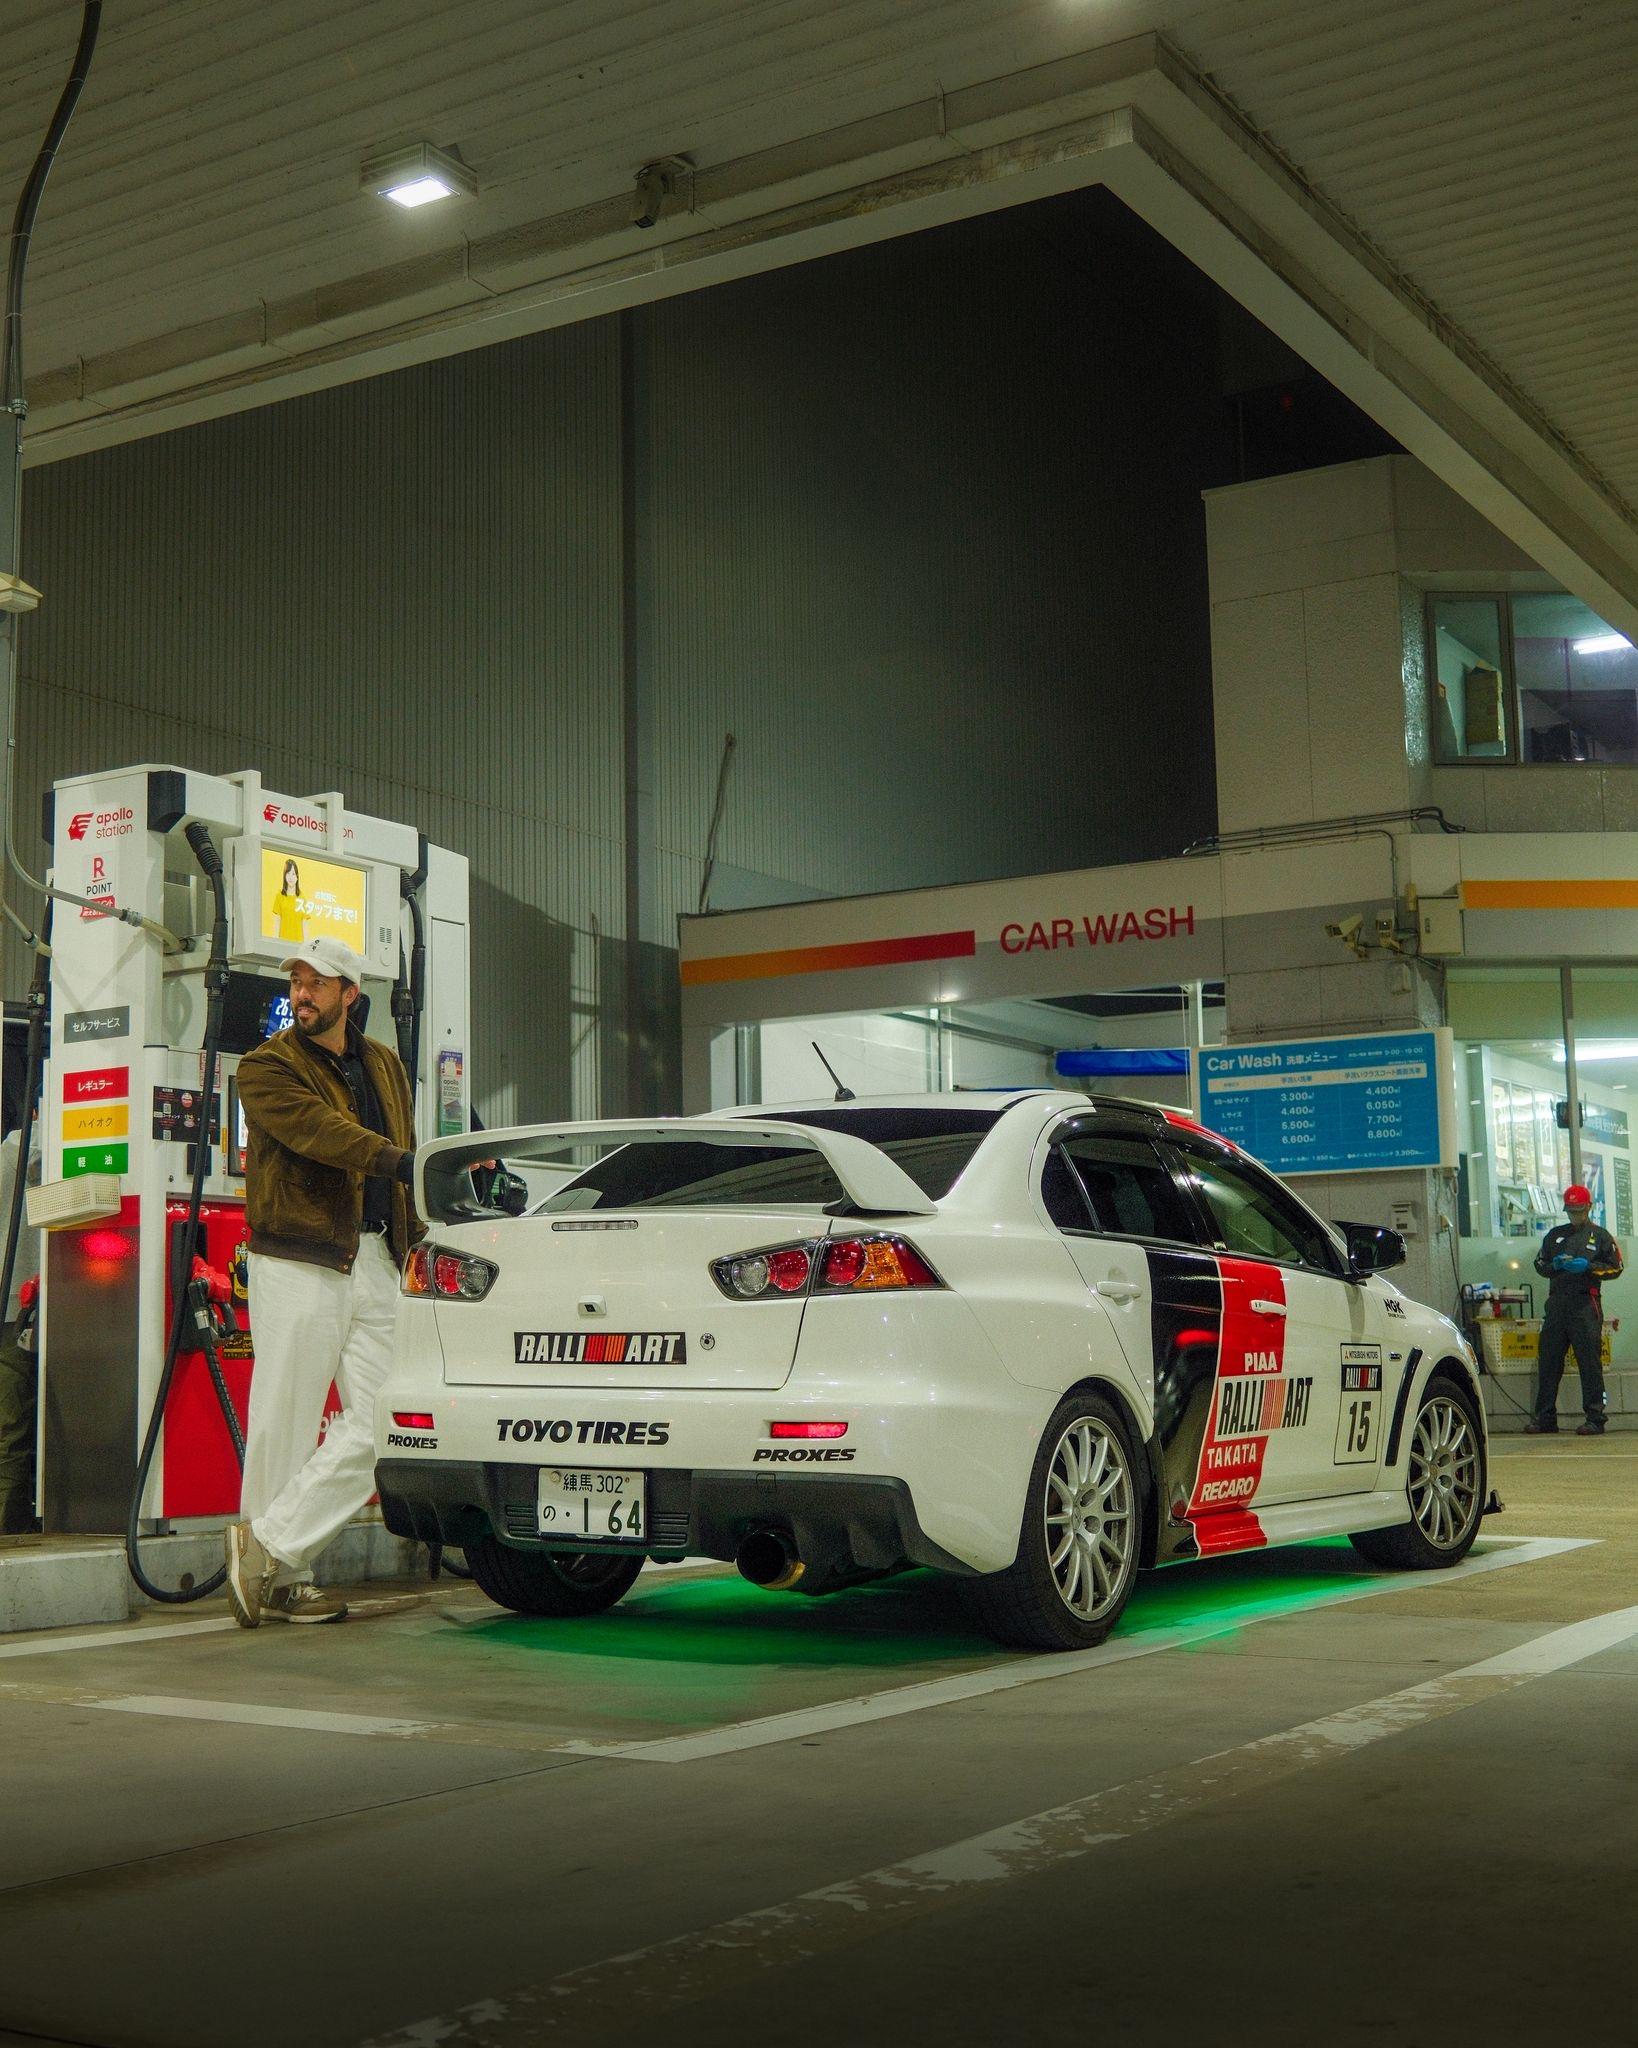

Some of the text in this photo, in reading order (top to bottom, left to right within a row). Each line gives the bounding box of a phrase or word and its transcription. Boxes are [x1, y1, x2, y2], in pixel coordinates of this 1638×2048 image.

[96, 807, 133, 827] apollo
[96, 823, 133, 839] station
[93, 857, 105, 878] R
[86, 882, 113, 896] POINT
[1000, 905, 1194, 954] CAR WASH
[72, 1017, 121, 1033] セルフサービス
[1206, 1057, 1236, 1072] Car
[1238, 1053, 1282, 1069] Wash
[78, 1079, 114, 1093] レギュラー
[78, 1116, 113, 1129] ハイオク
[1382, 1297, 1405, 1315] NGK
[1244, 1351, 1278, 1373] PIAA
[497, 1418, 671, 1446] TOYO TIRES
[1347, 1400, 1372, 1453] 15
[387, 1433, 439, 1450] PROXES
[752, 1448, 857, 1463] PROXES
[1207, 1442, 1257, 1470] TAKATA
[562, 1473, 624, 1494] 練馬 302
[1199, 1476, 1255, 1503] RECARO
